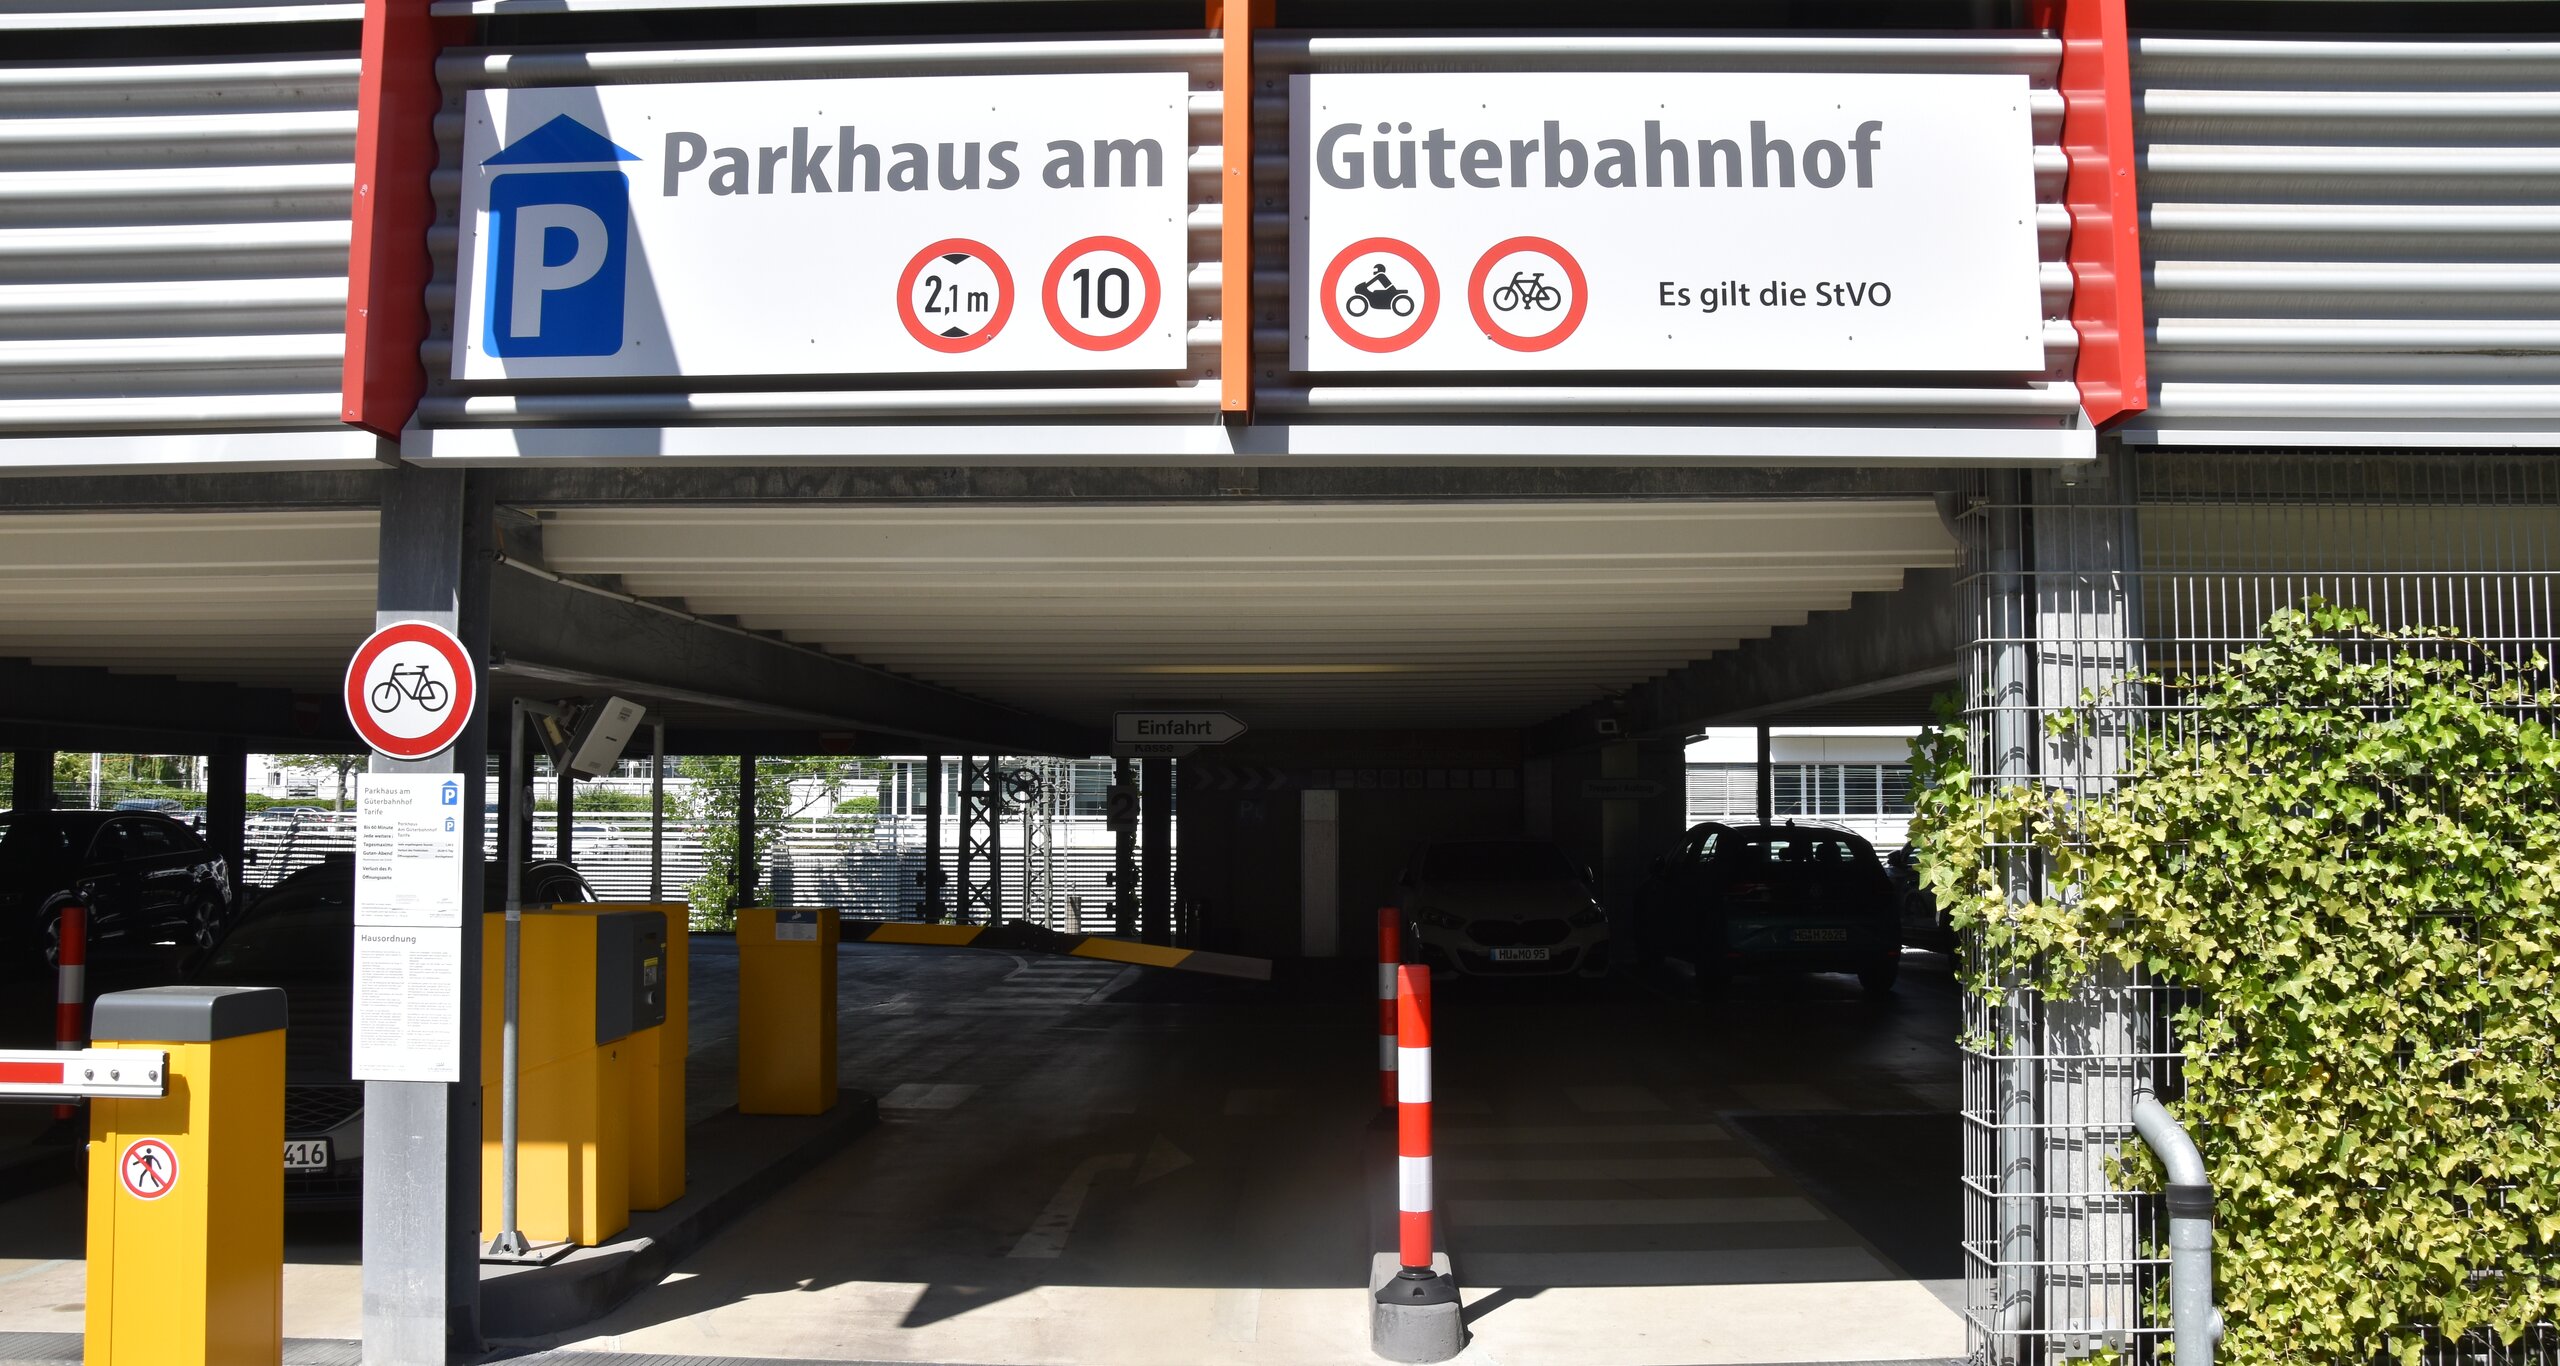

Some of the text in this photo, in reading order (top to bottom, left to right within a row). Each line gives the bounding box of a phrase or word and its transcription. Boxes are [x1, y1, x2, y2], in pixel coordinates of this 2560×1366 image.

[661, 125, 1164, 198] Parkhaus am
[1316, 119, 1882, 190] Güterbahnhof
[510, 203, 609, 338] P
[924, 275, 990, 316] 2,1 m
[1073, 267, 1130, 319] 10
[1658, 280, 1892, 313] Es gilt die StVO
[1137, 720, 1212, 735] Einfahrt
[1134, 744, 1174, 753] Kasse
[364, 787, 398, 795] Parkhaus
[1110, 791, 1134, 825] 2
[361, 934, 417, 944] Hausordnung
[1533, 949, 1546, 959] 95
[284, 1143, 325, 1165] 416
